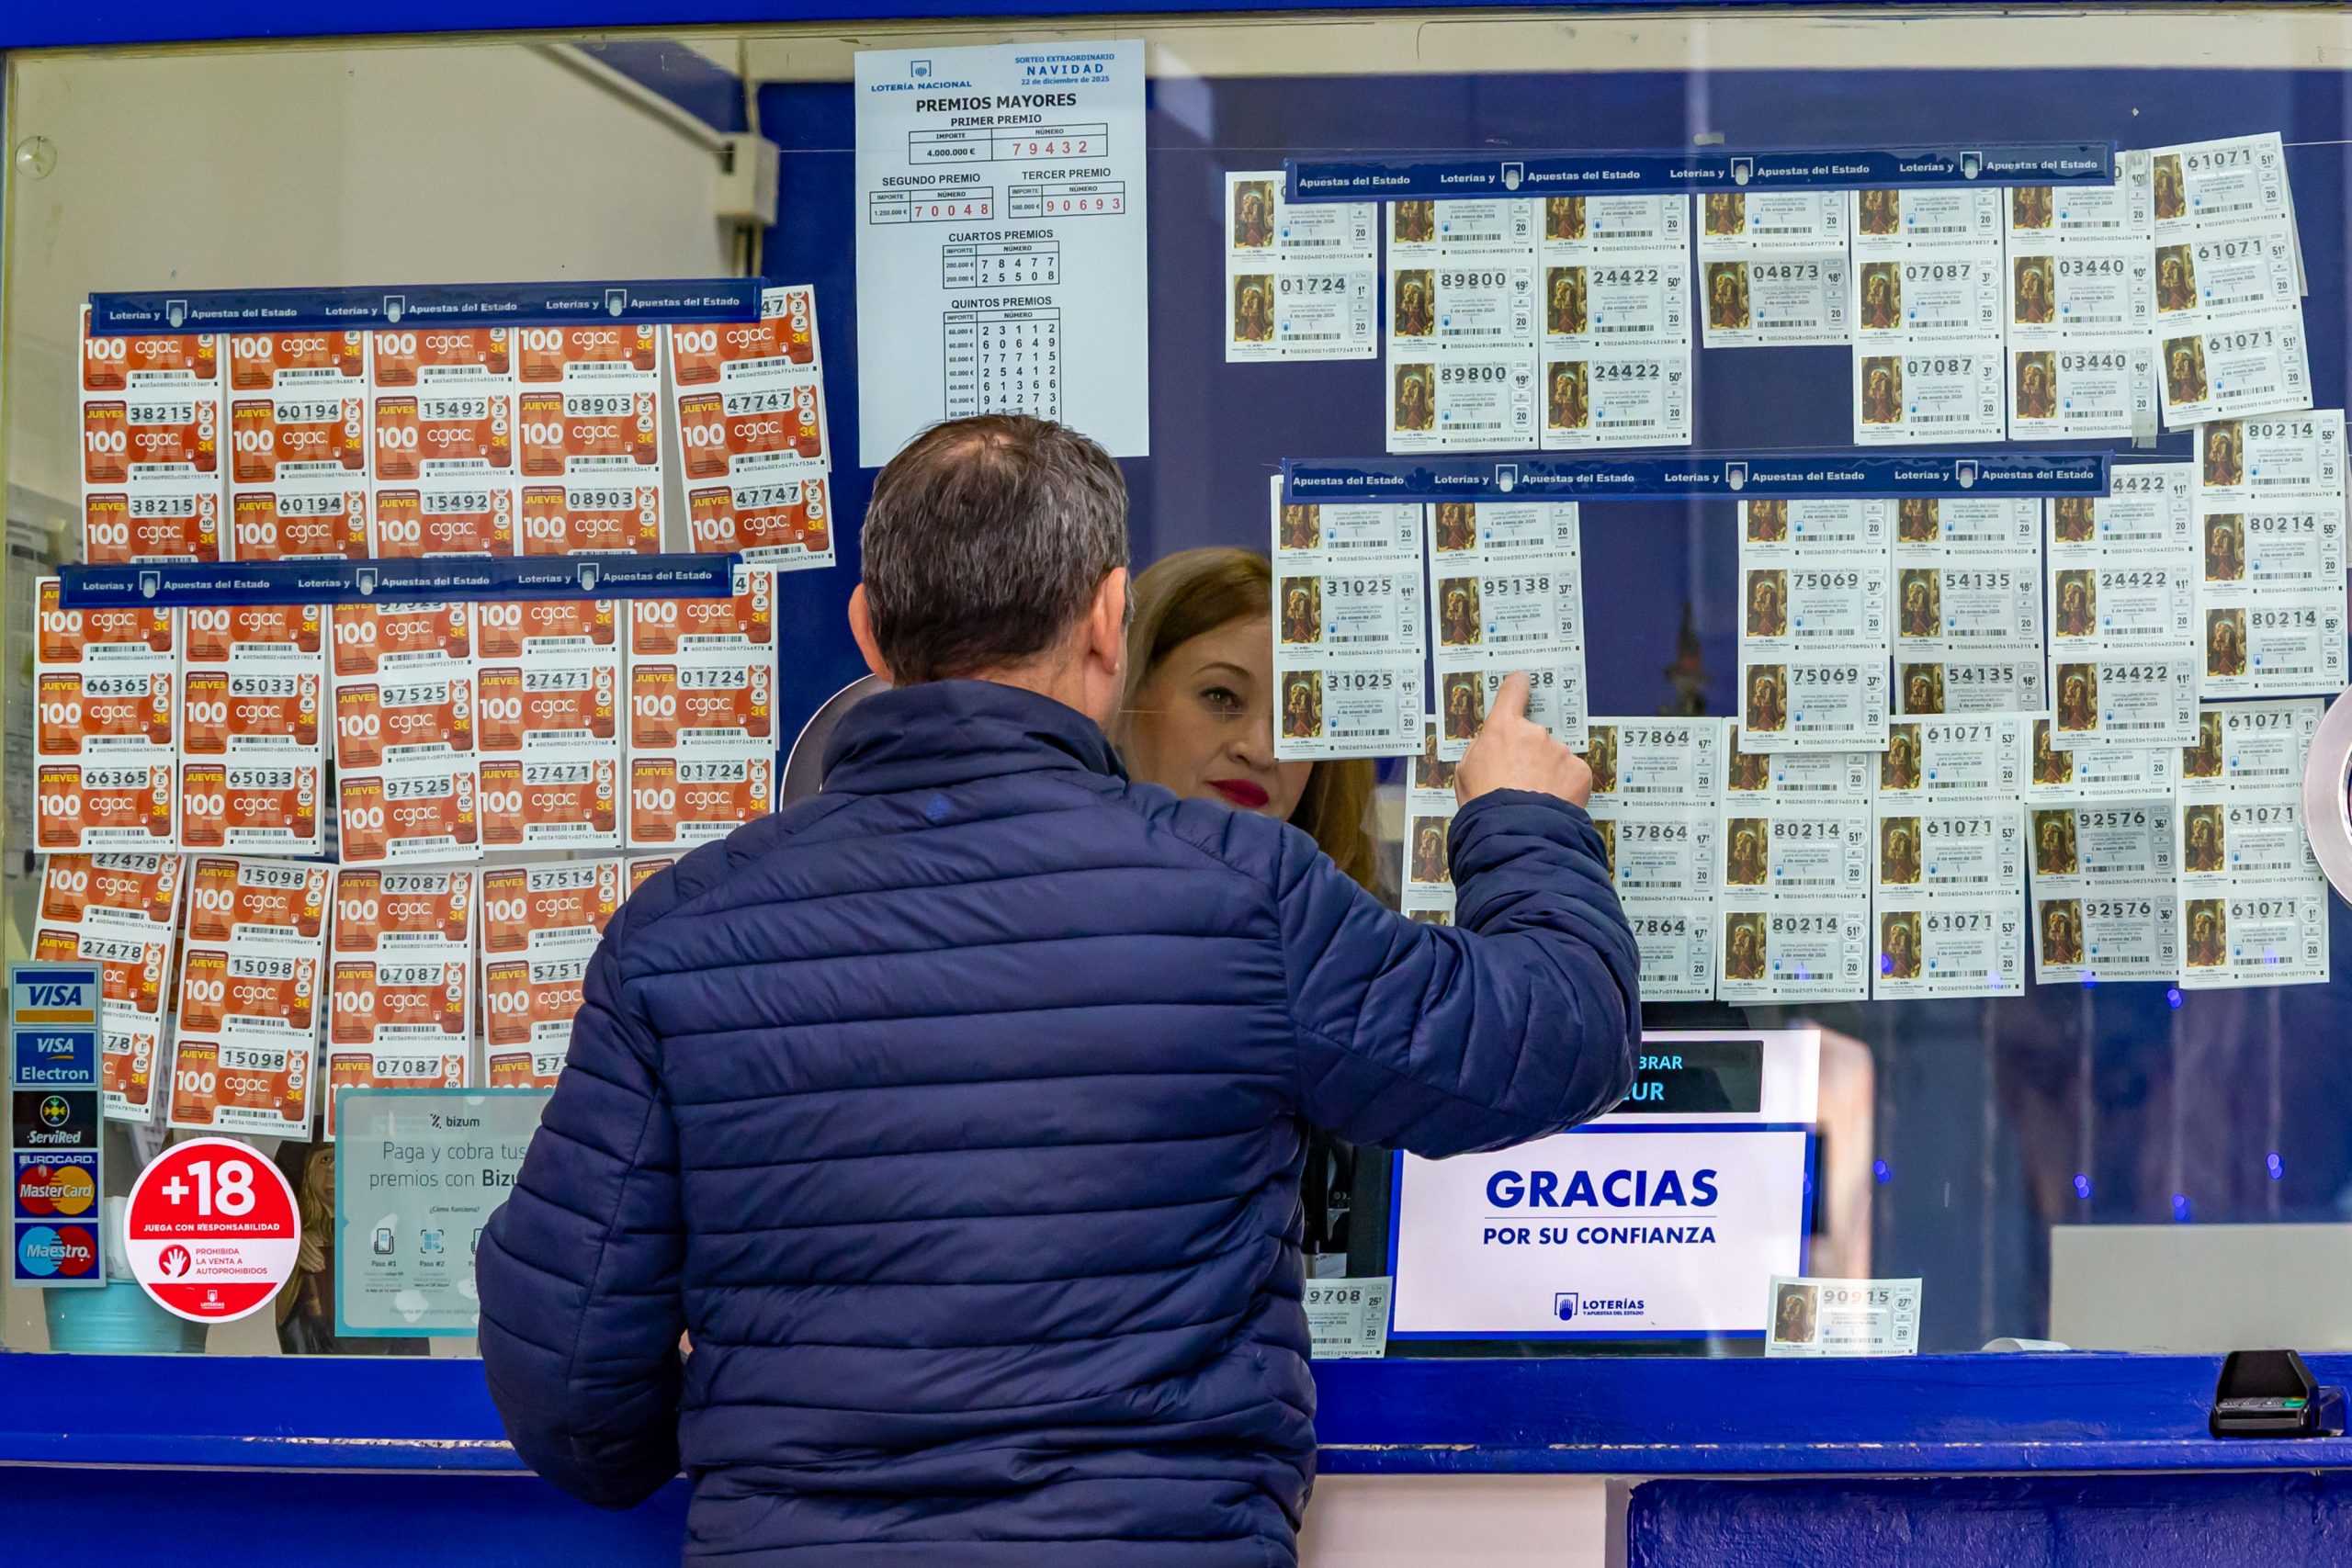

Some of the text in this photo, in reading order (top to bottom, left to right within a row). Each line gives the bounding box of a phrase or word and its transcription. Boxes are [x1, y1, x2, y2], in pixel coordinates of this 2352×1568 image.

[1046, 53, 1114, 62] EXTRAORDINARIO
[1026, 64, 1103, 75] NAVIDAD
[871, 81, 972, 93] LOTERÍA NACIONAL
[916, 94, 1077, 112] PREMIOS MAYORES
[951, 114, 1042, 127] PRIMER PREMIO
[927, 149, 967, 157] 4.000.000
[2188, 149, 2250, 168] 61071
[1023, 168, 1111, 180] TERCER PREMIO
[1947, 164, 1953, 173] y
[1987, 162, 2037, 171] Apuestas
[2041, 161, 2057, 169] del
[2061, 161, 2098, 169] Estado
[882, 174, 980, 186] SEGUNDO PREMIO
[948, 230, 1054, 242] CUARTOS PREMIOS
[1754, 265, 1818, 278] 04873
[1906, 264, 1971, 280] 07087
[2060, 260, 2124, 275] 03440
[1442, 273, 1506, 287] 89800
[1594, 270, 1658, 285] 24422
[1281, 278, 1346, 292] 01724
[951, 297, 1052, 309] QUINTOS PREMIOS
[153, 312, 161, 321] y
[191, 310, 240, 320] Apuestas
[243, 309, 258, 317] del
[262, 309, 298, 317] Estado
[424, 400, 485, 417] 15492
[567, 399, 631, 413] 08903
[728, 393, 791, 412] 47747
[88, 411, 124, 419] JUEVES
[131, 407, 192, 421] 38215
[277, 404, 339, 420] 60194
[2250, 423, 2312, 437] 80214
[86, 431, 127, 452] 100
[198, 441, 214, 451] 3€
[1942, 472, 1950, 480] y
[1983, 470, 2033, 479] Apuestas
[2037, 470, 2052, 479] del
[2056, 470, 2094, 479] Estado
[564, 576, 571, 584] y
[604, 573, 653, 582] Apuestas
[676, 571, 712, 580] Estado
[1794, 573, 1858, 587] 75069
[1946, 573, 2009, 588] 54135
[2102, 572, 2165, 587] 24422
[1327, 580, 1391, 595] 31025
[1485, 578, 1550, 594] 95138
[232, 678, 295, 692] 65033
[526, 672, 588, 687] 27471
[635, 674, 674, 686] JUEVES
[681, 671, 745, 685] 01724
[1329, 674, 1392, 689] 31025
[86, 679, 148, 693] 66365
[385, 687, 447, 703] 97525
[633, 695, 676, 716] 100
[751, 706, 768, 716] 3€
[1624, 731, 1689, 744] 57864
[1928, 726, 1991, 740] 61071
[2080, 811, 2145, 827] 92576
[2231, 807, 2293, 822] 61071
[1774, 823, 1839, 837] 80214
[243, 868, 304, 885] 15098
[384, 876, 447, 890] 07087
[532, 871, 594, 887] 57514
[2086, 902, 2151, 917] 92576
[2232, 901, 2295, 917] 61071
[83, 941, 141, 958] 27478
[28, 986, 82, 1006] VISA
[37, 1038, 74, 1052] VISA
[224, 1051, 285, 1067] 15098
[22, 1066, 89, 1080] Electron
[1623, 1083, 1664, 1100] UR
[446, 1116, 480, 1127] bizum
[28, 1131, 82, 1144] ServiRed
[383, 1142, 526, 1164] Paga y cobra tus
[370, 1170, 438, 1190] premios
[446, 1174, 475, 1187] con
[20, 1184, 92, 1198] MasterCard
[162, 1160, 255, 1216] +18
[1487, 1169, 1718, 1208] GRACIAS
[1484, 1226, 1716, 1245] POR SU CONFIANZA
[27, 1245, 88, 1258] Maestro
[1583, 1298, 1645, 1309] LOTERÍAS
[1824, 1291, 1889, 1303] 90915
